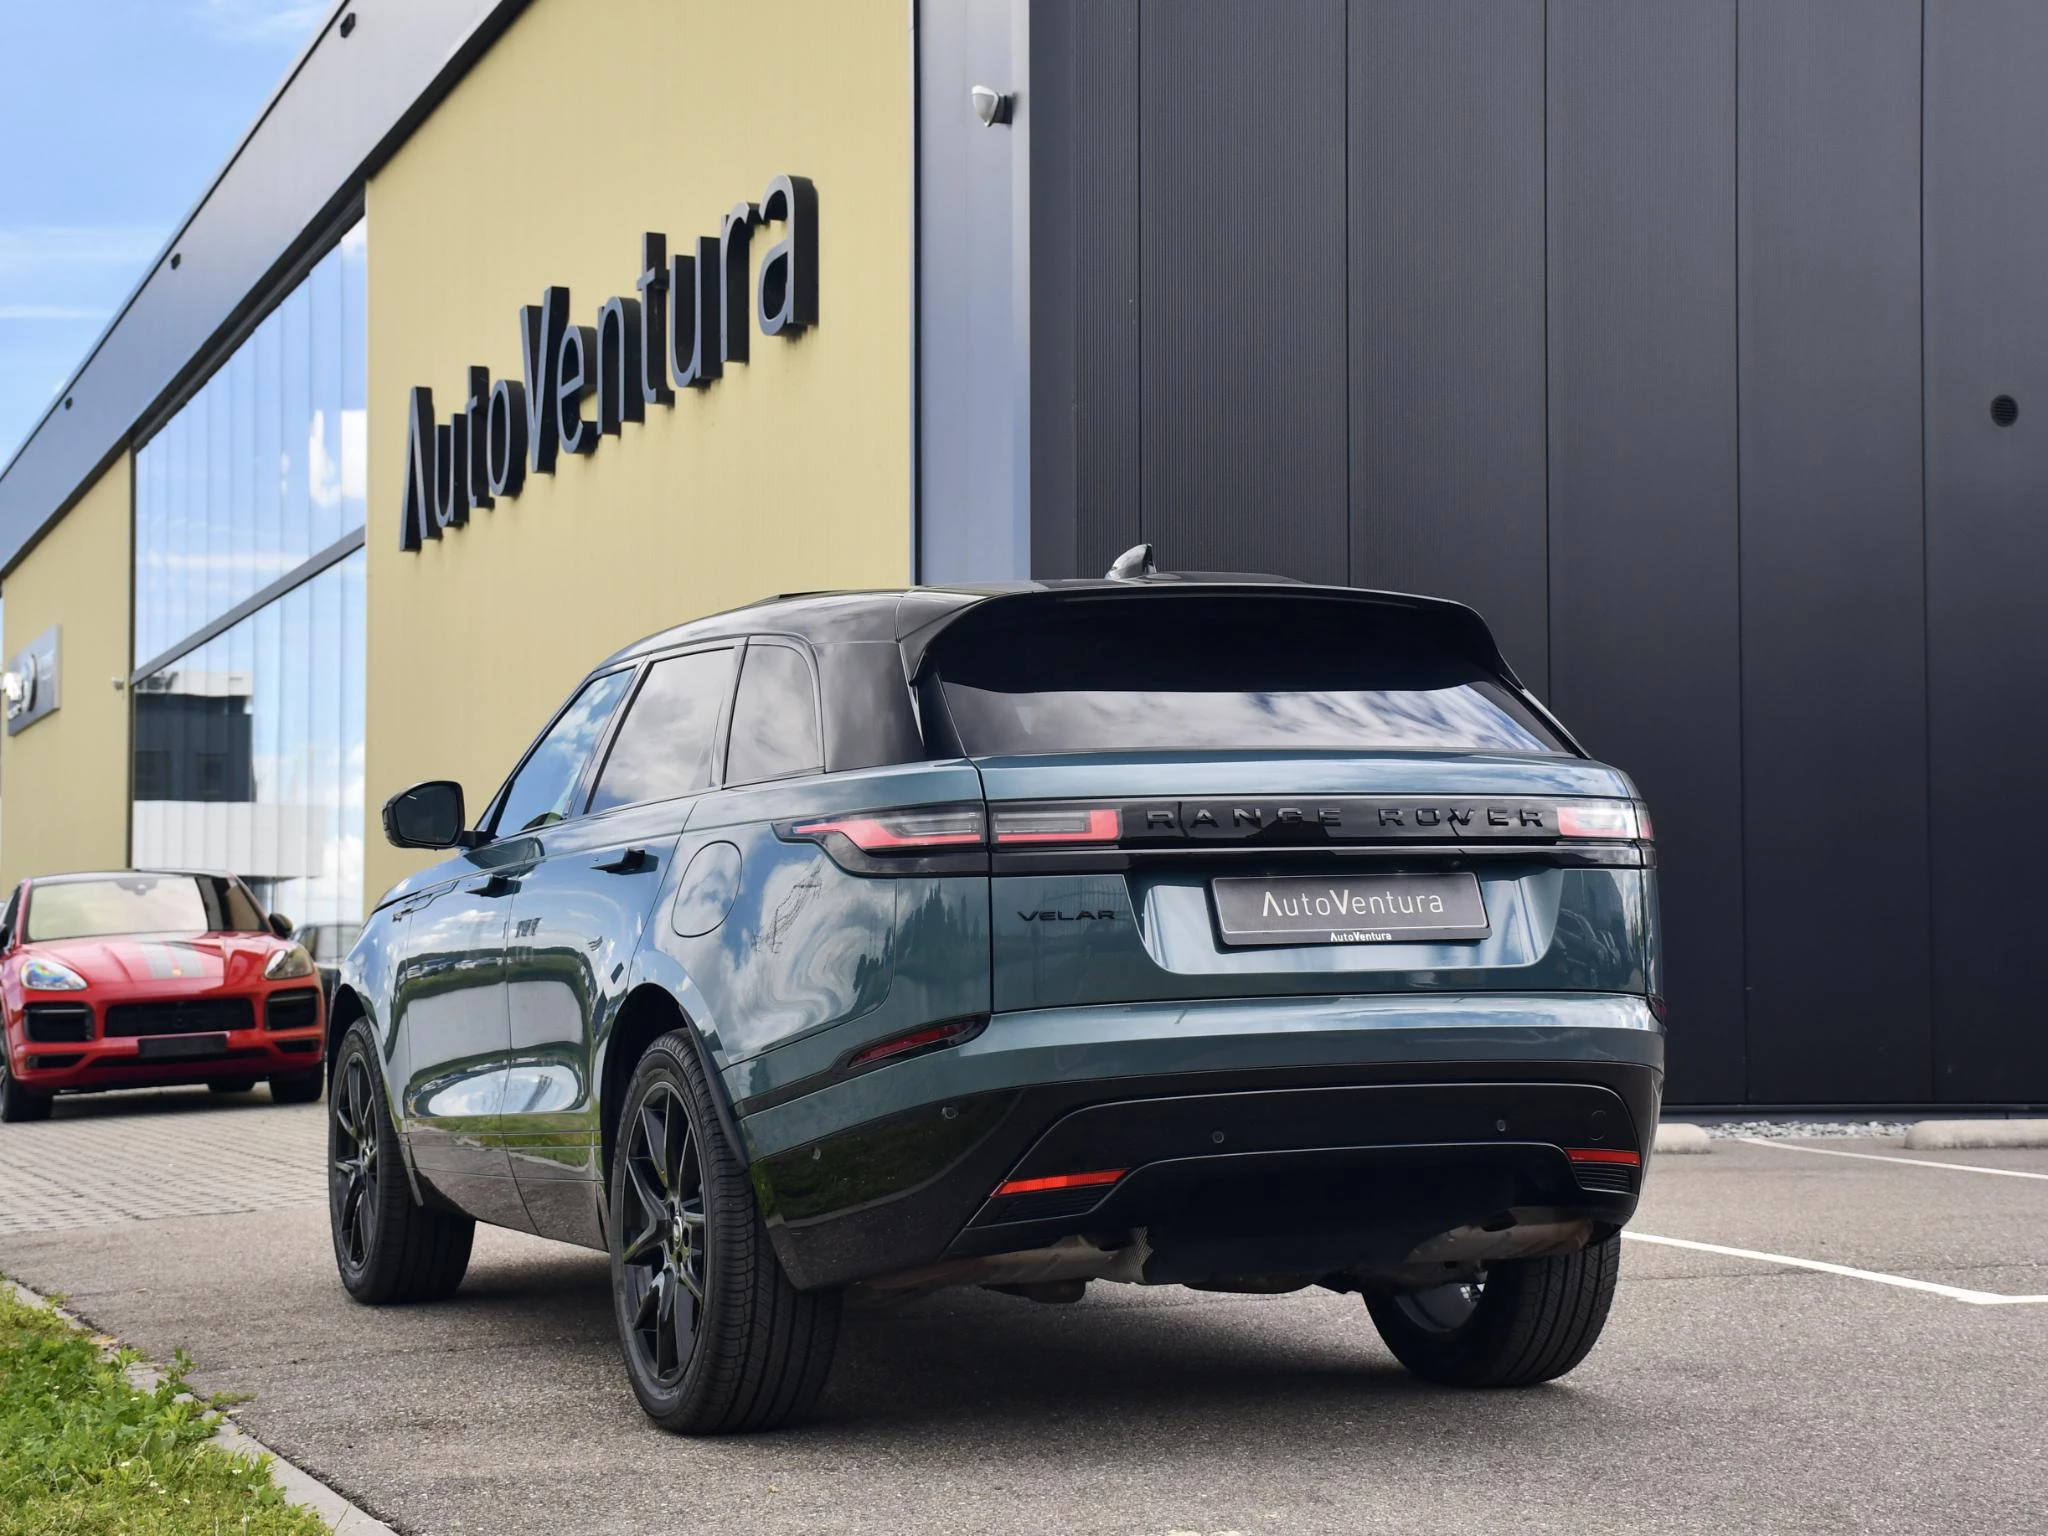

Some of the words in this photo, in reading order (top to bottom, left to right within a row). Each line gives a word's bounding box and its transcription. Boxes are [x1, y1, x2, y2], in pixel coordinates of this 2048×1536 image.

[400, 174, 819, 552] AutoVentura
[1146, 807, 1342, 829] RANGE
[1377, 808, 1544, 827] ROVER
[1262, 889, 1444, 917] AutoVentura
[1017, 910, 1115, 921] VELAR
[1330, 931, 1392, 942] AutoVentura
